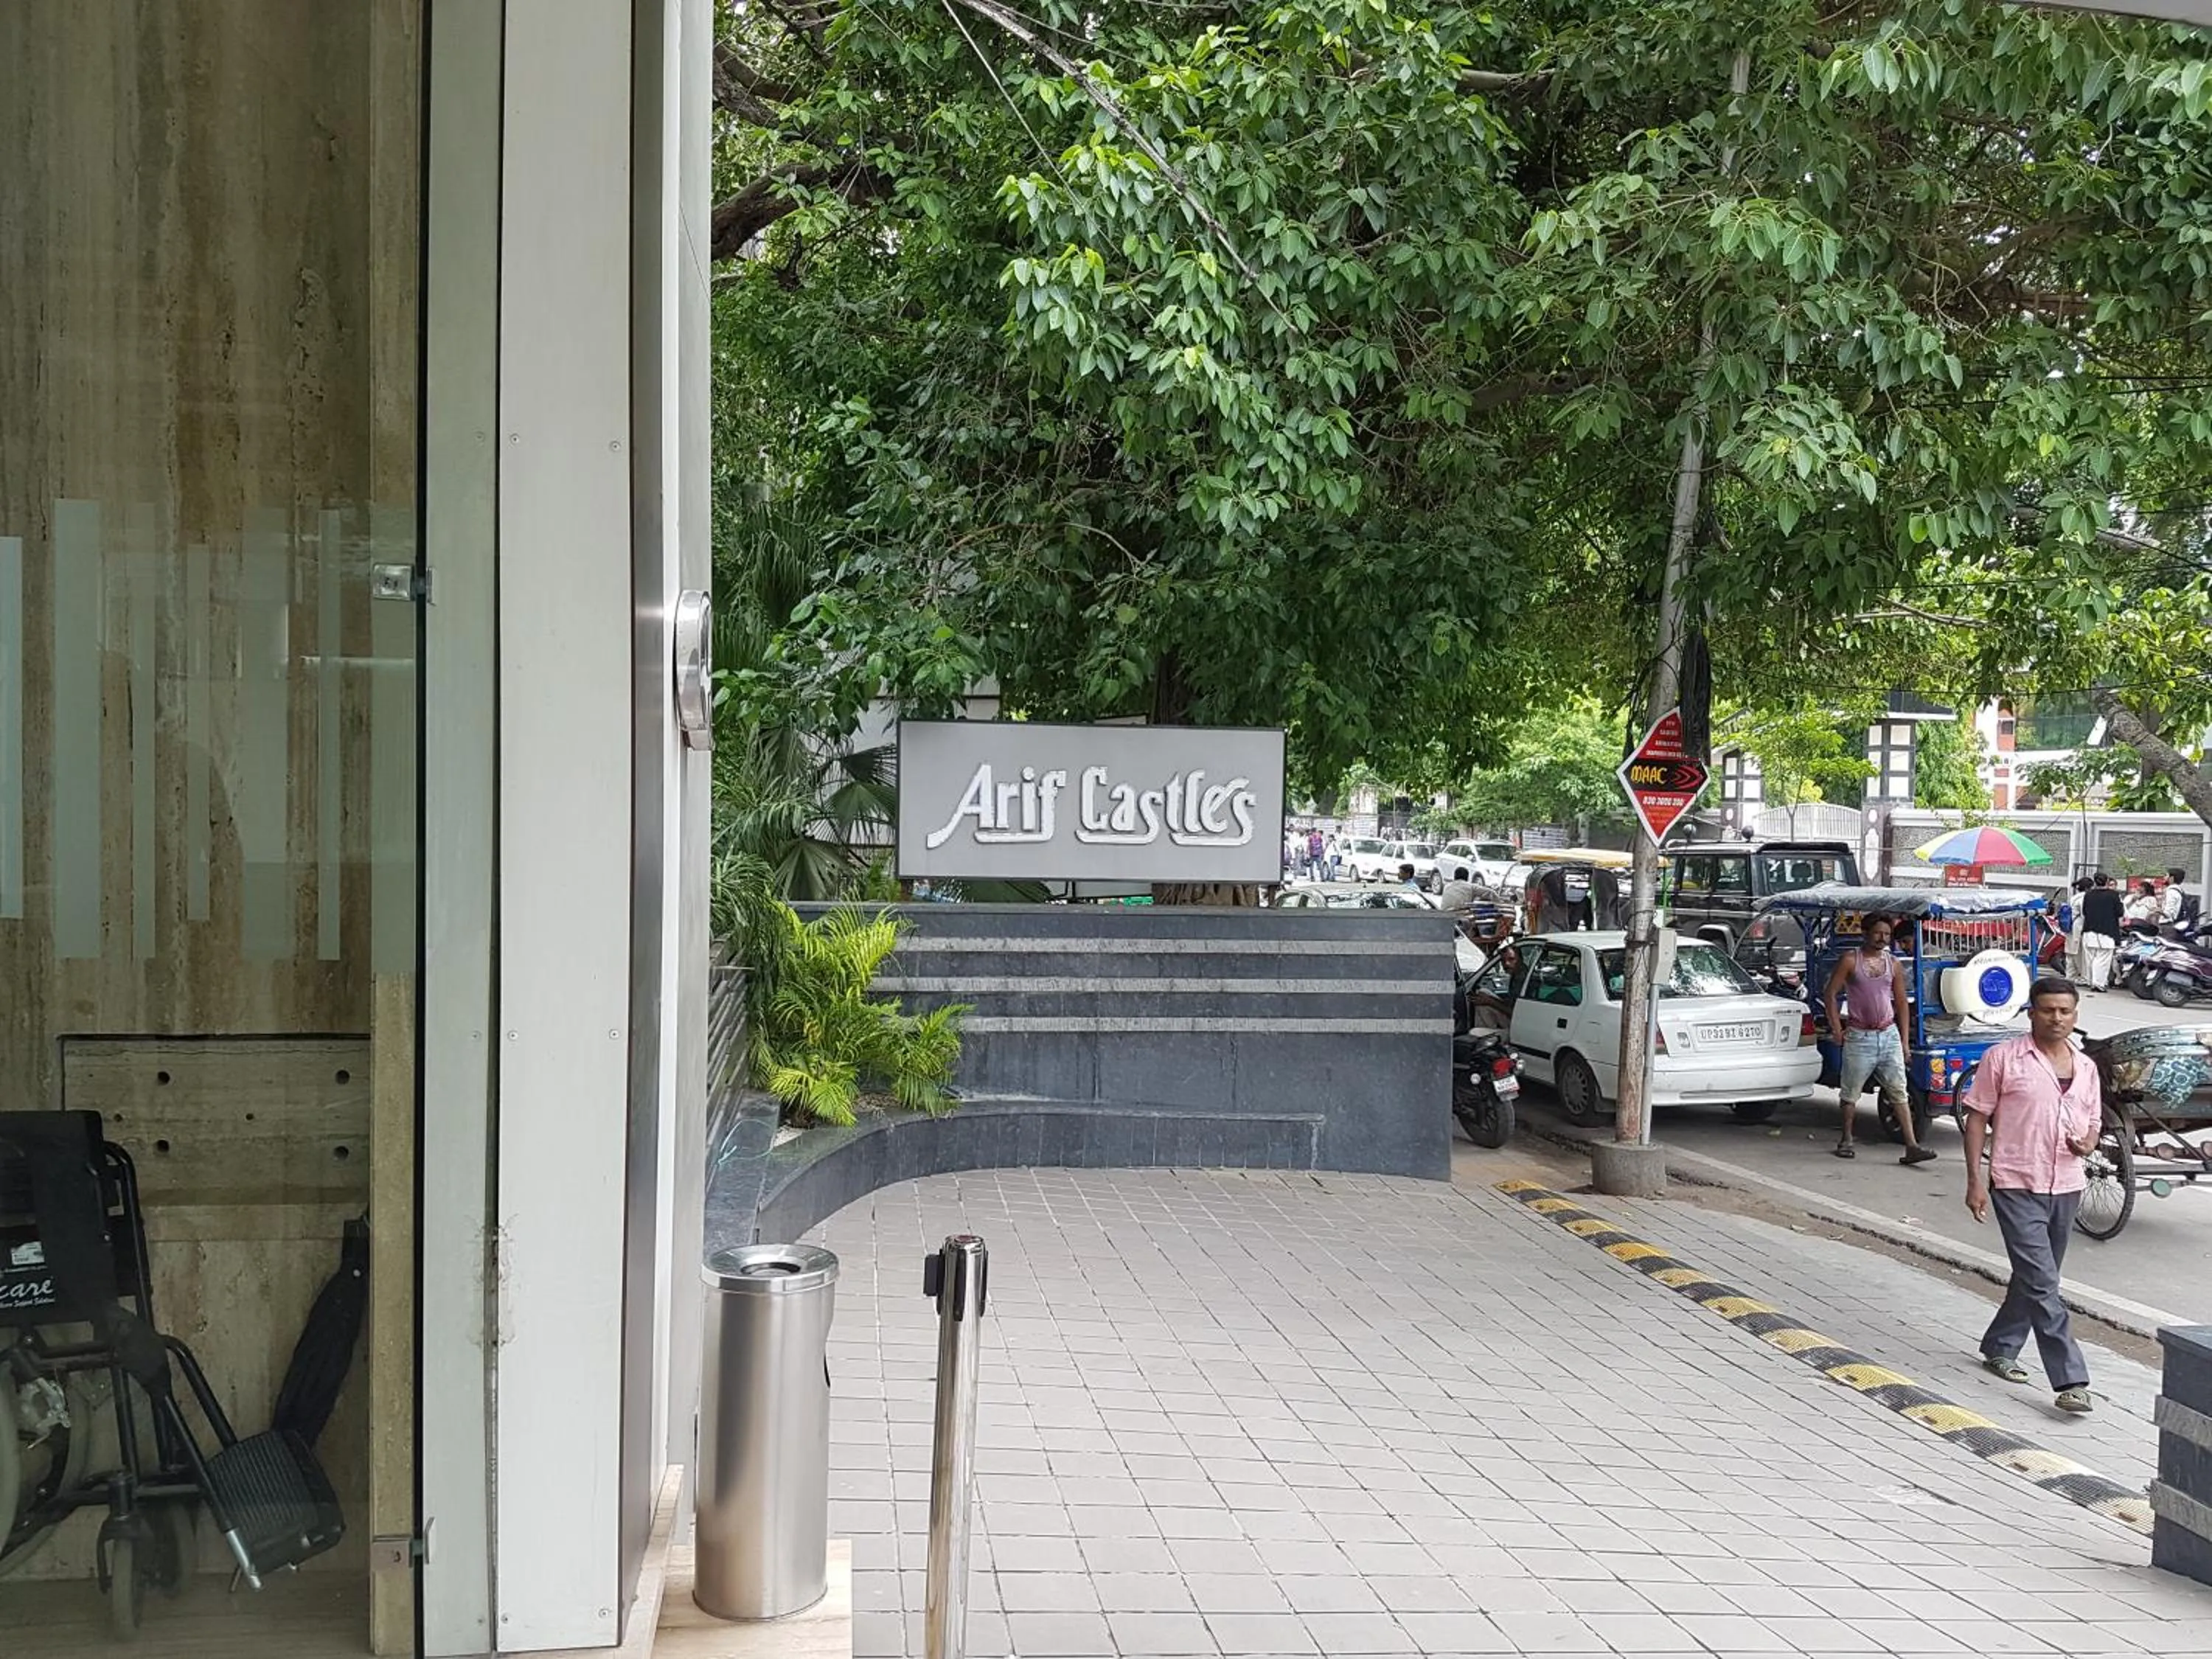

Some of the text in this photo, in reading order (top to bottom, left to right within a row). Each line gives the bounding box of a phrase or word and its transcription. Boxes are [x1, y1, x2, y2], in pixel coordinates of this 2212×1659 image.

[1630, 765, 1668, 785] MAAC
[926, 764, 1256, 849] Arif Castles
